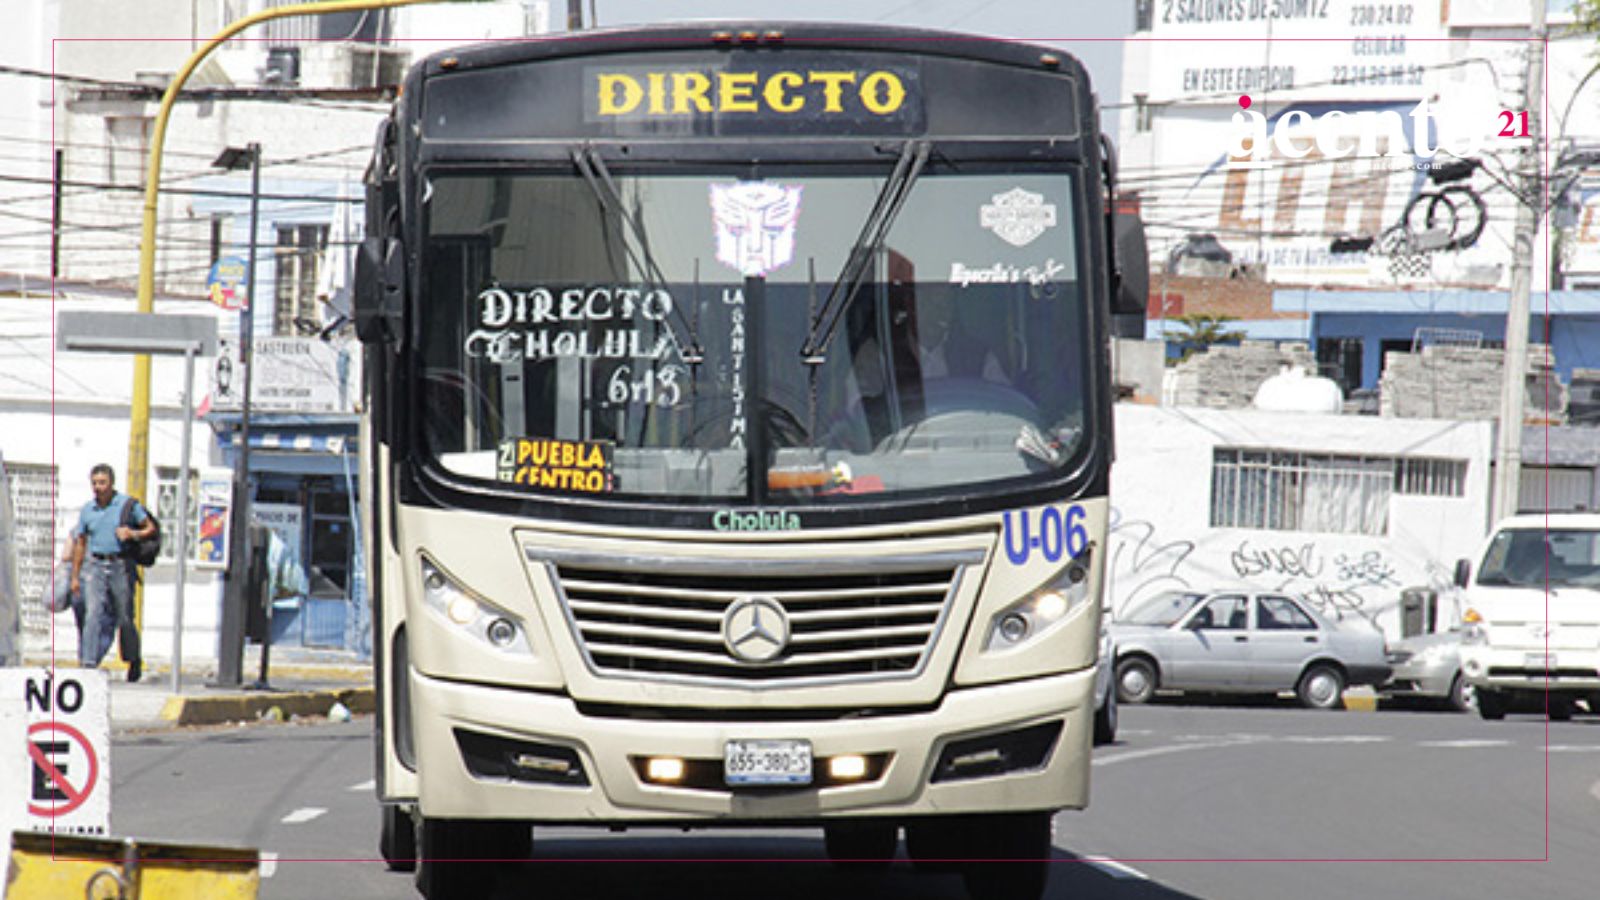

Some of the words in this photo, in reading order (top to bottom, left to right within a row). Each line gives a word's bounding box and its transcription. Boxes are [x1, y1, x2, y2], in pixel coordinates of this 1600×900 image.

[1177, 0, 1245, 24] SALONES
[597, 70, 906, 115] DIRECTO
[1202, 68, 1233, 91] ESTE
[479, 287, 673, 326] DIRECTO
[722, 289, 745, 304] LA
[516, 439, 606, 468] PUEBLA
[514, 466, 606, 492] CENTRO
[712, 509, 802, 531] Cholula
[1003, 505, 1087, 565] U-06
[26, 678, 84, 713] NO
